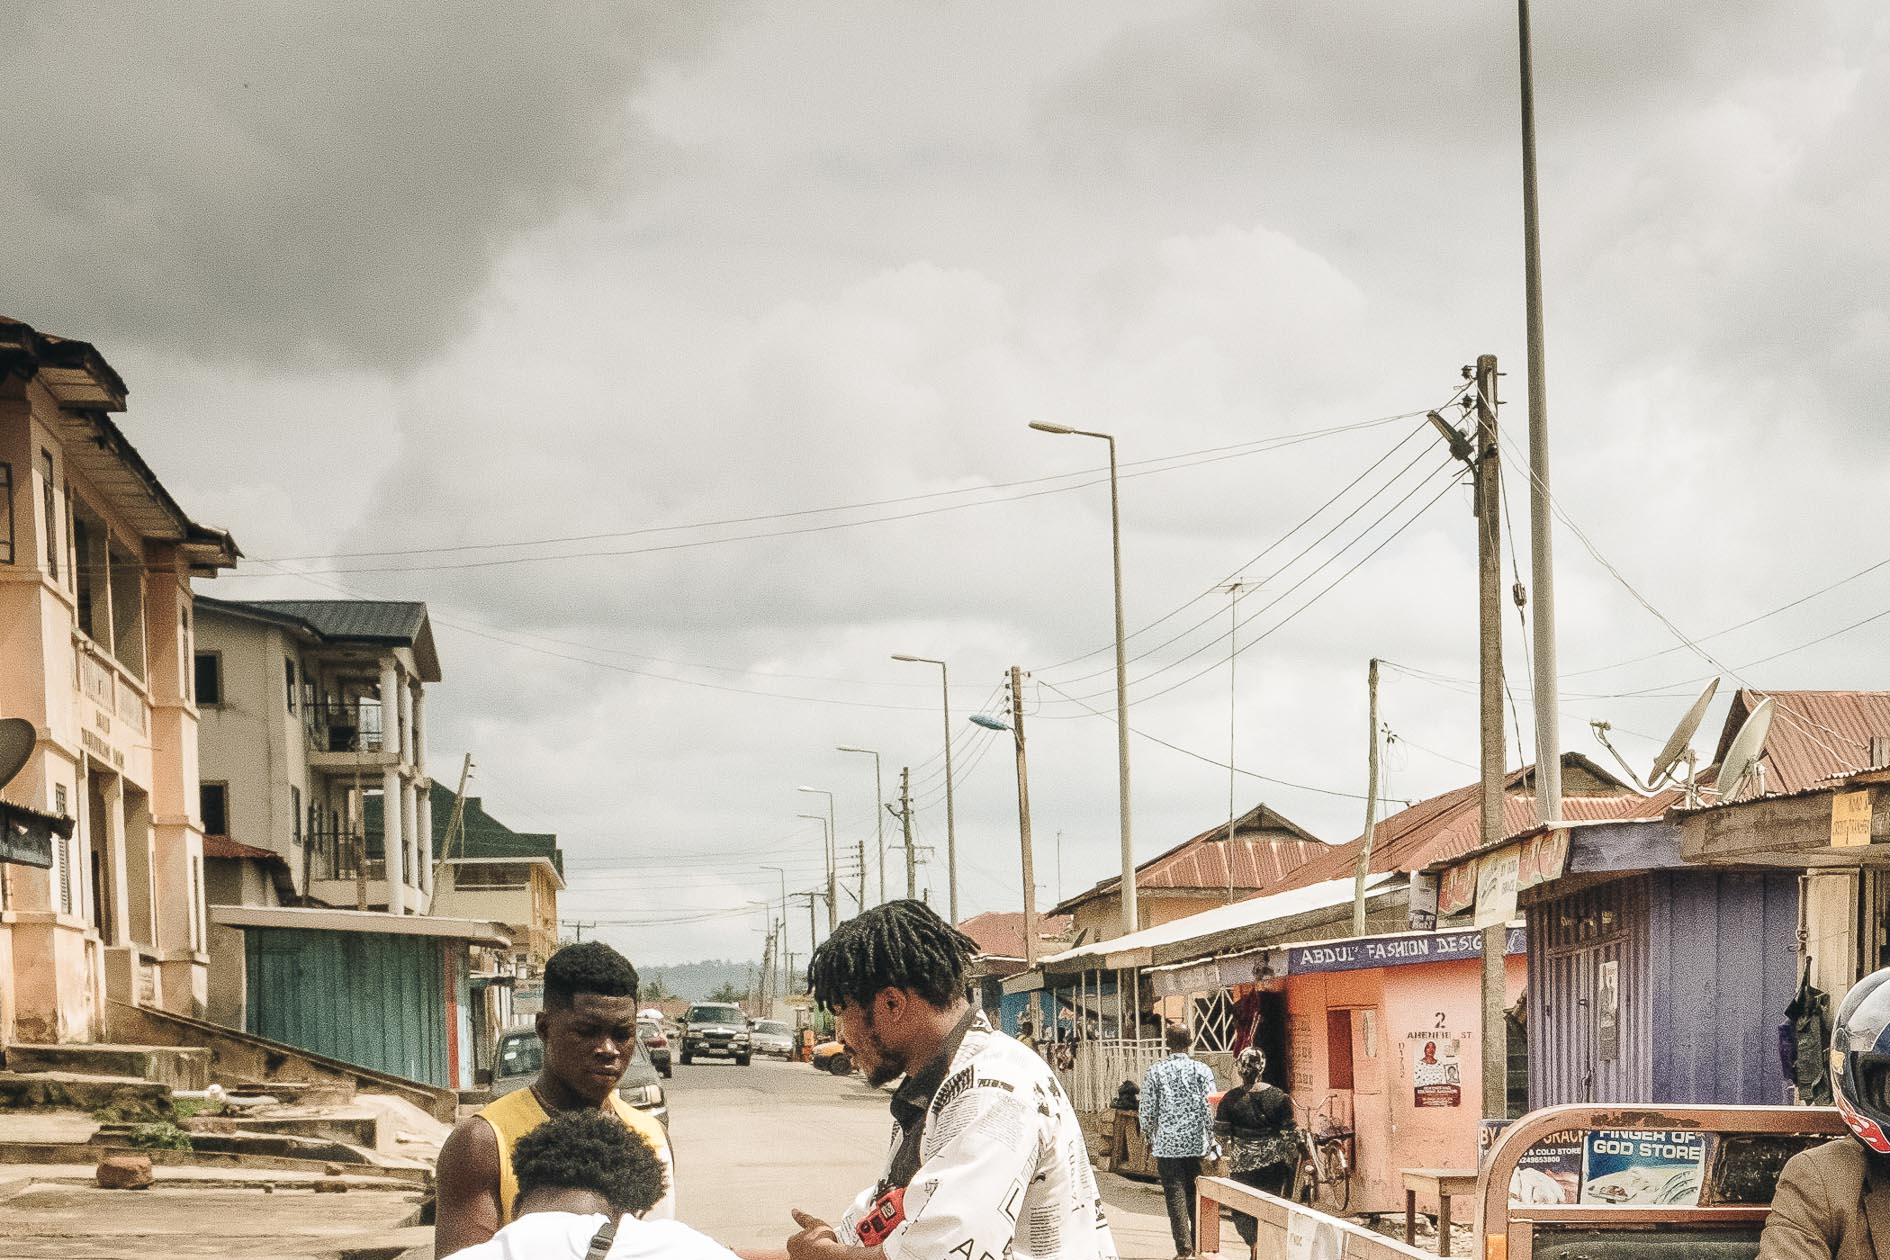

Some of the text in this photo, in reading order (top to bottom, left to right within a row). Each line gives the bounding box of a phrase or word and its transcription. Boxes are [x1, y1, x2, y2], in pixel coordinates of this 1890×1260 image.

[1366, 938, 1429, 960] FASHION
[1434, 1011, 1446, 1029] 2
[1480, 1127, 1497, 1146] BY
[1671, 1131, 1695, 1144] OF
[1536, 1148, 1556, 1156] COLD
[1557, 1147, 1581, 1157] STORE
[1593, 1140, 1700, 1161] GOD STORE
